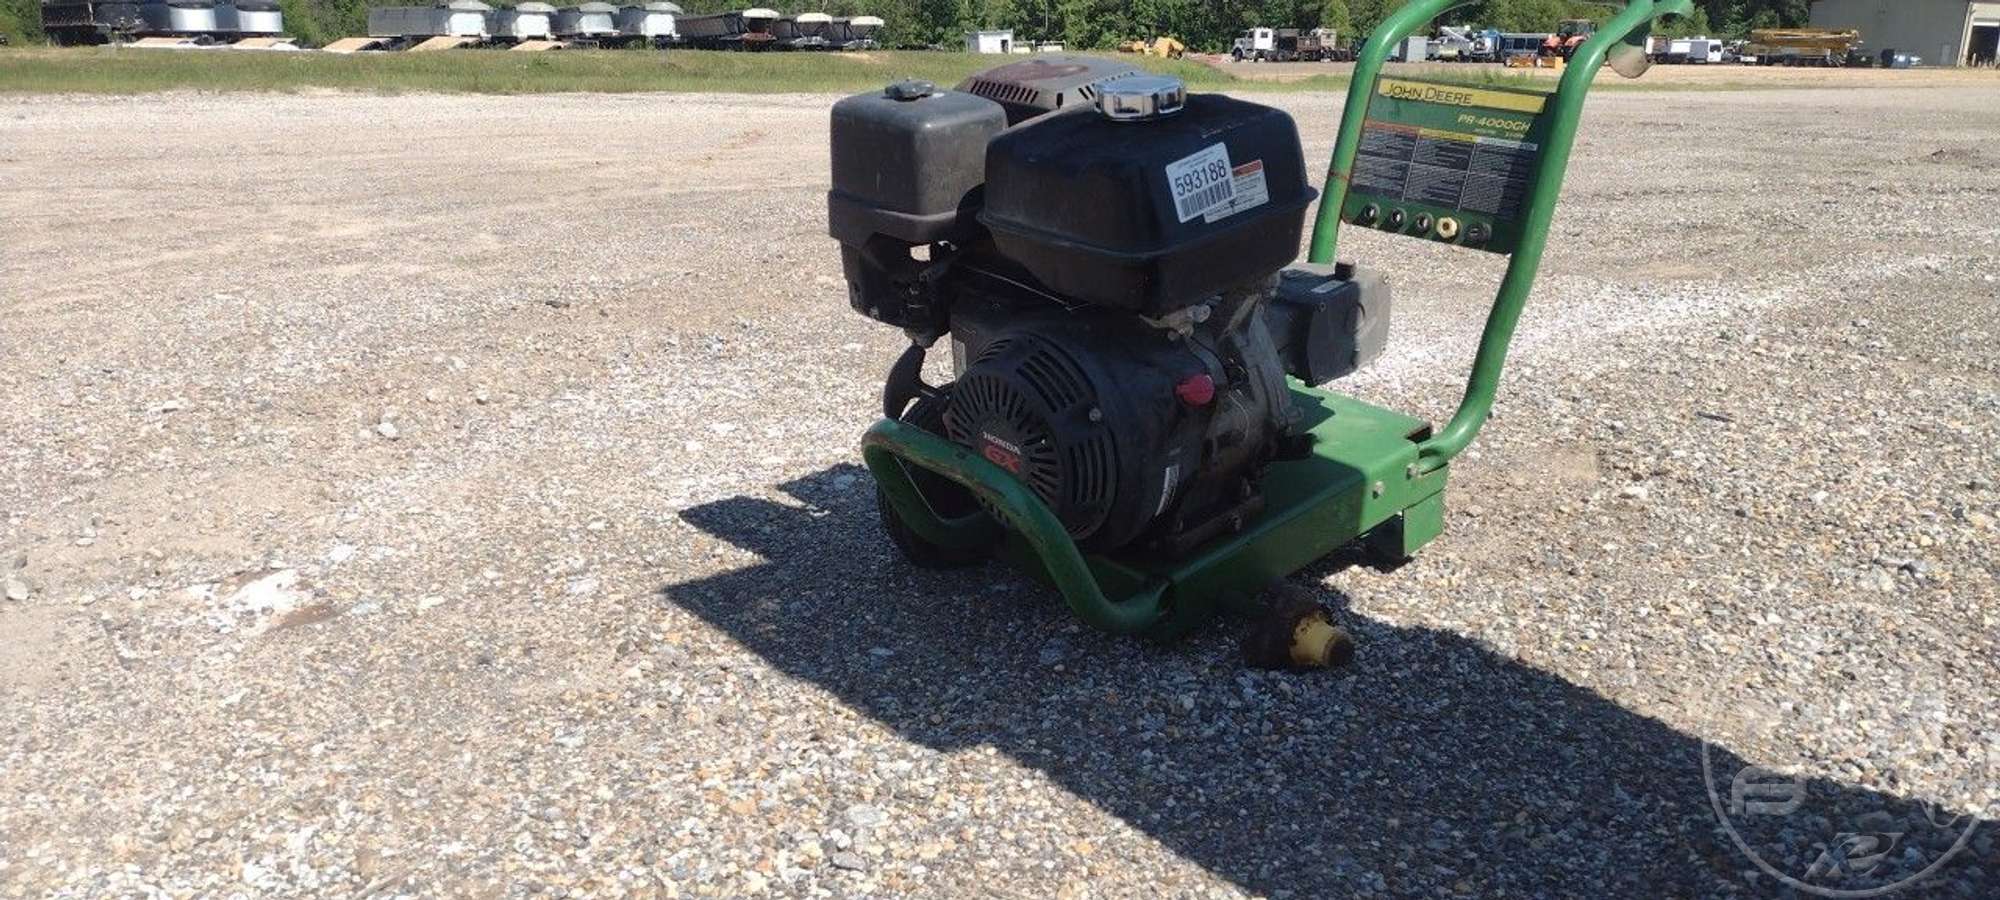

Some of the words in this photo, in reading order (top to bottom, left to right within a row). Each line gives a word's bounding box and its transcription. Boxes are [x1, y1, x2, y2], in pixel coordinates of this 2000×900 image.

[1384, 83, 1422, 99] JOHN
[1425, 87, 1474, 104] DEERE
[1174, 159, 1227, 197] 593188
[982, 431, 1021, 455] HONDA
[984, 446, 1021, 473] GX
